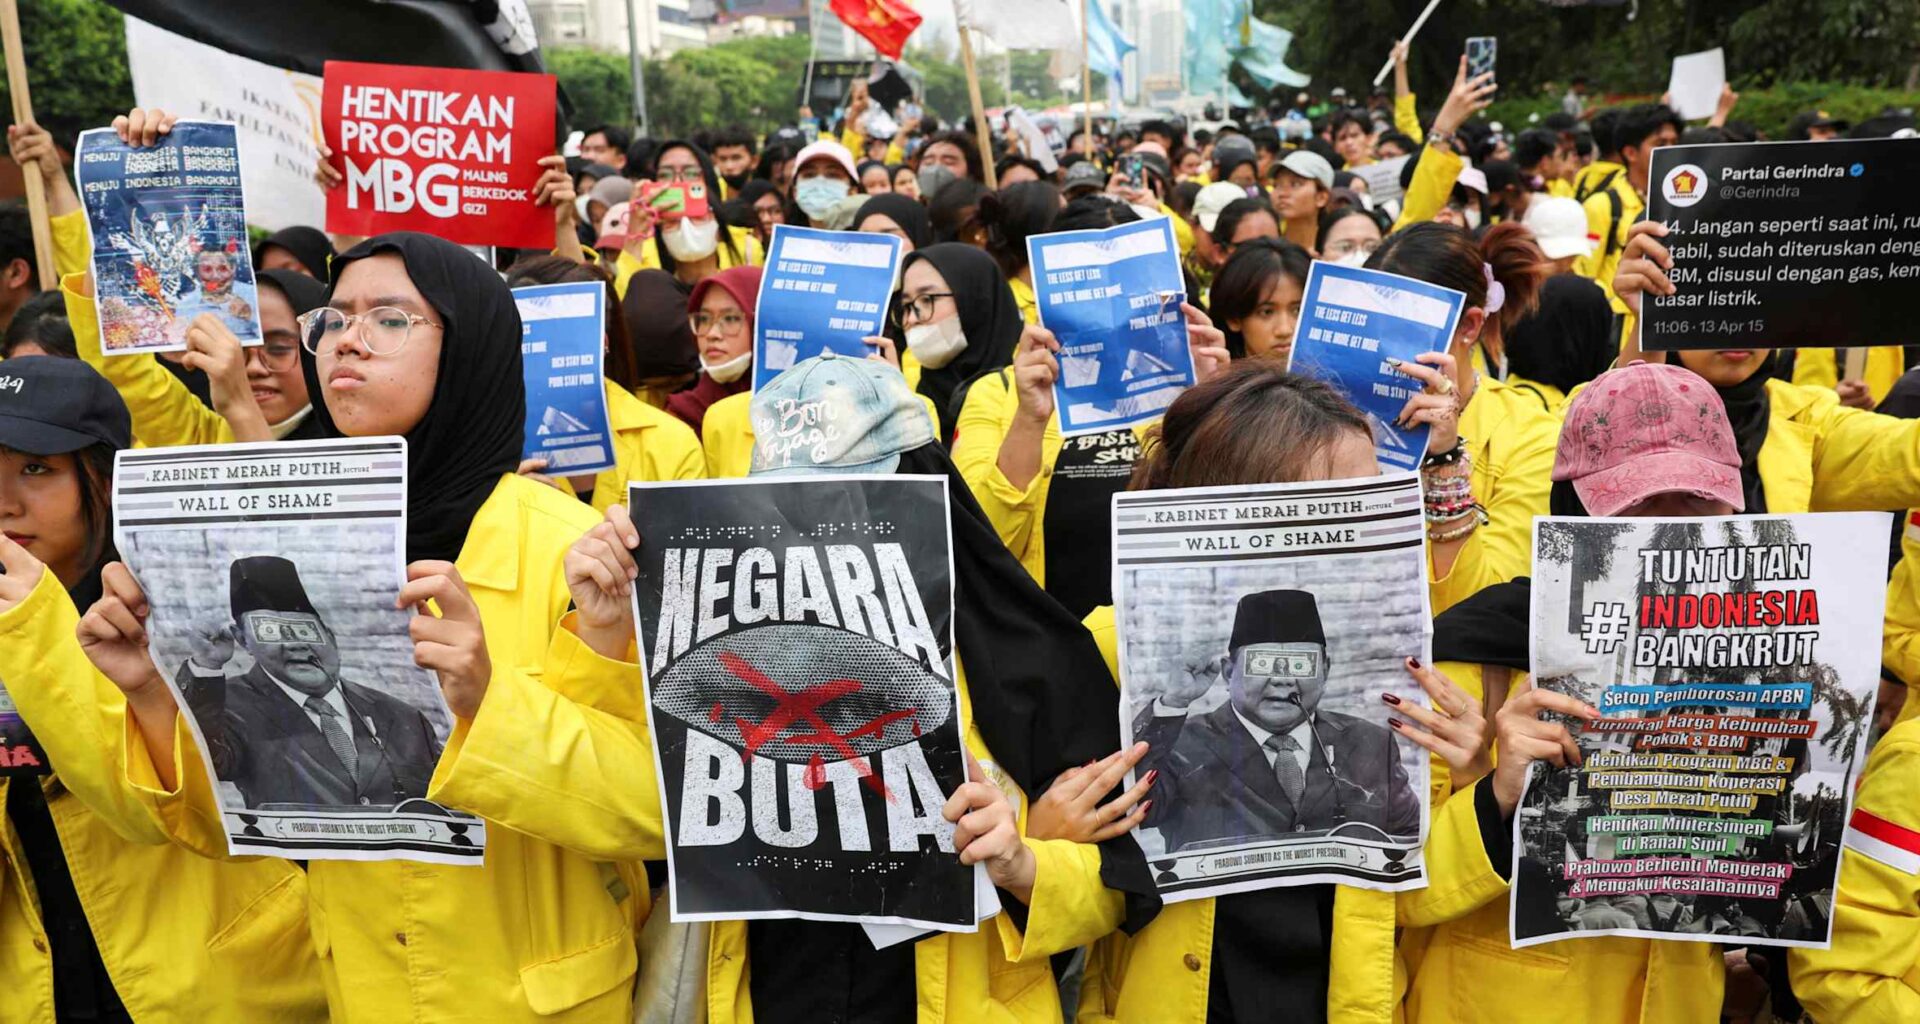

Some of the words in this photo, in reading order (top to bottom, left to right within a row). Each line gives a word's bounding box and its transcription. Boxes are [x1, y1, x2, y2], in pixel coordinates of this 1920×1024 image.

[342, 85, 514, 129] HENTIKAN
[341, 120, 511, 164] PROGRAM
[84, 152, 121, 163] MENUJU
[127, 147, 178, 162] INDONESIA
[182, 146, 236, 157] BANGKRUT
[463, 170, 508, 183] MALING
[1722, 166, 1770, 180] Partai
[1773, 164, 1845, 179] Gerindra
[84, 179, 120, 192] MENUJU
[125, 176, 182, 188] INDONESIA
[186, 176, 238, 186] BANGKRUT
[345, 155, 460, 218] MBG
[463, 186, 528, 201] BERKEDOK
[1720, 184, 1800, 200] @Gerindra
[463, 203, 487, 215] GIZI
[1690, 220, 1754, 238] Jangan
[1759, 216, 1824, 236] seperti
[1828, 216, 1870, 231] saat
[1873, 213, 1898, 232] ini,
[1669, 242, 1713, 260] tabil,
[1718, 241, 1774, 258] sudah
[1779, 239, 1876, 257] diteruskan
[1058, 271, 1074, 284] LESS
[1086, 268, 1101, 280] LESS
[1664, 267, 1702, 284] BM,
[1707, 265, 1772, 284] disusul
[1776, 264, 1844, 284] dengan
[1848, 266, 1884, 283] gas,
[1708, 290, 1762, 306] listrik.
[1314, 306, 1327, 319] THE
[1326, 308, 1340, 322] LESS
[1340, 310, 1352, 324] GET
[1351, 313, 1368, 327] LESS
[1654, 321, 1689, 334] 11:06
[1700, 320, 1716, 333] 13
[1718, 320, 1744, 334] Apr
[1749, 319, 1764, 332] 15
[1308, 328, 1322, 342] AND
[1322, 330, 1333, 343] THE
[1350, 336, 1362, 350] GET
[1390, 386, 1406, 400] STAY
[774, 398, 838, 438] Bon
[152, 466, 220, 482] KABINET
[226, 464, 281, 478] MERAH
[288, 462, 342, 476] PUTIH
[343, 466, 370, 474] PICTURE
[179, 496, 230, 512] WALL
[238, 495, 260, 509] OF
[268, 492, 332, 508] SHAME
[1154, 508, 1228, 523] KABINET
[1235, 504, 1298, 520] MERAH
[1307, 500, 1363, 516] PUTIH
[1364, 502, 1392, 510] PICTURE
[1186, 535, 1240, 550] WALL
[1248, 534, 1274, 548] OF
[1284, 530, 1355, 546] SHAME
[1638, 544, 1811, 584] TUNTUTAN
[650, 542, 950, 681] NEGARA
[1638, 589, 1820, 629] INDONESIA
[1634, 631, 1820, 668] BANGKRUT
[1604, 689, 1650, 707] Setop
[1654, 688, 1756, 706] Pemborosan
[1760, 688, 1804, 704] APBN
[1666, 714, 1714, 731] Harga
[1718, 716, 1810, 735] Kebutuhan
[1642, 734, 1688, 747] Pokok
[1693, 735, 1702, 746] &
[1707, 734, 1745, 748] BBM
[1590, 752, 1659, 768] Hentikan
[1662, 753, 1732, 771] Program
[1736, 756, 1772, 770] MBG
[1776, 758, 1786, 770] &
[678, 728, 958, 853] BUTA
[1591, 772, 1704, 790] Pembangunan
[1708, 774, 1782, 791] Koperasi
[1614, 791, 1650, 806] Desa
[1655, 792, 1704, 807] Merah
[1709, 792, 1752, 808] Putih
[291, 822, 319, 833] PRABOWO
[320, 823, 346, 834] SUBIANTO
[346, 824, 355, 834] AS
[355, 824, 366, 834] THE
[366, 824, 386, 834] WORST
[386, 824, 417, 834] PRESIDENT
[1592, 816, 1658, 832] Hentikan
[1662, 816, 1765, 836] Militersimen
[1622, 836, 1636, 850] di
[1640, 837, 1687, 850] Ranah
[1690, 836, 1728, 852] Sipil
[1214, 856, 1242, 869] PRABOWO
[1244, 852, 1272, 865] SUBIANTO
[1273, 851, 1282, 860] AS
[1282, 850, 1292, 860] THE
[1294, 848, 1314, 859] WORST
[1316, 847, 1346, 858] PRESIDENT
[1568, 862, 1632, 877] Prabowo
[1635, 858, 1702, 874] Berhenti
[1706, 860, 1786, 879] Mengelak
[1572, 884, 1582, 894] &
[1585, 878, 1658, 894] Mengakui
[1662, 877, 1776, 898] Kesalahannya
